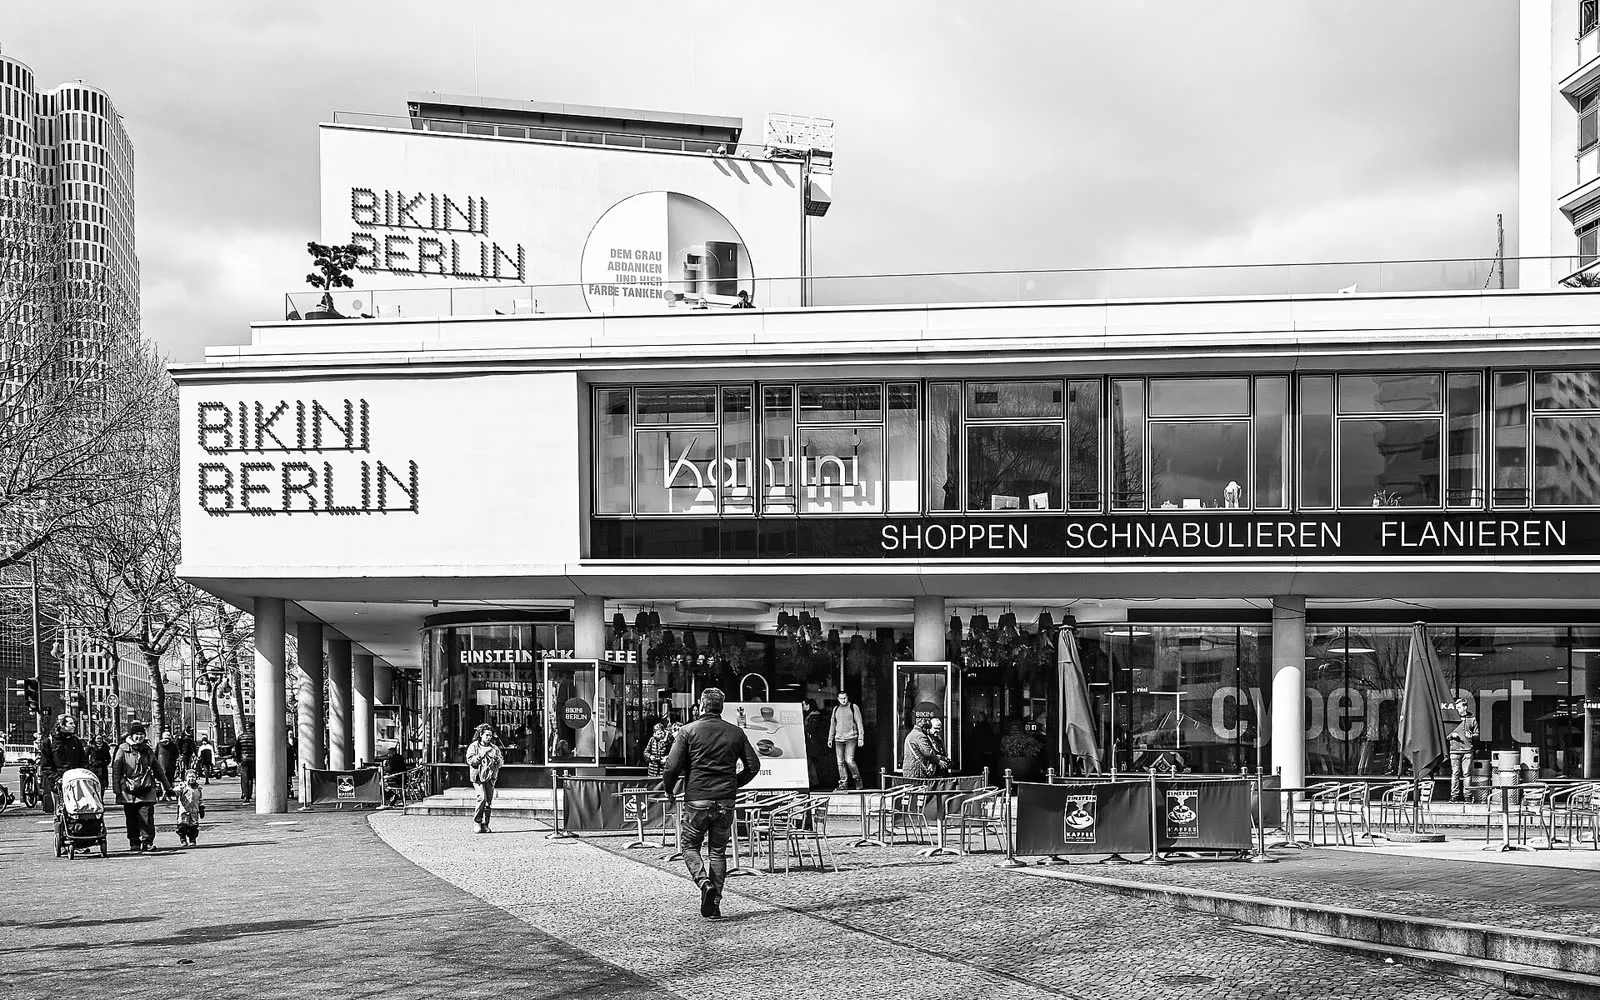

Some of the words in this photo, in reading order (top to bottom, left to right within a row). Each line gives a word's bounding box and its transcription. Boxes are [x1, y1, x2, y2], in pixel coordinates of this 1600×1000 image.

[352, 187, 488, 237] BIKINI
[352, 232, 526, 284] BERLIN
[607, 261, 662, 274] ABDANKEN
[610, 248, 632, 260] DEM
[635, 249, 662, 261] GRAU
[588, 284, 620, 297] FARBE
[622, 287, 663, 299] TANKEN
[616, 274, 637, 285] UND
[640, 275, 662, 286] HIER
[198, 399, 370, 455] BIKINI
[663, 434, 861, 489] Kantini
[198, 459, 419, 517] BERLIN
[881, 523, 1028, 550] SHOPPEN
[1066, 522, 1341, 549] SCHNABULIEREN
[1382, 520, 1566, 547] FLANIEREN
[460, 649, 533, 664] EINSTEIN
[560, 649, 637, 664] KFEE
[1211, 679, 1532, 749] cyberrt
